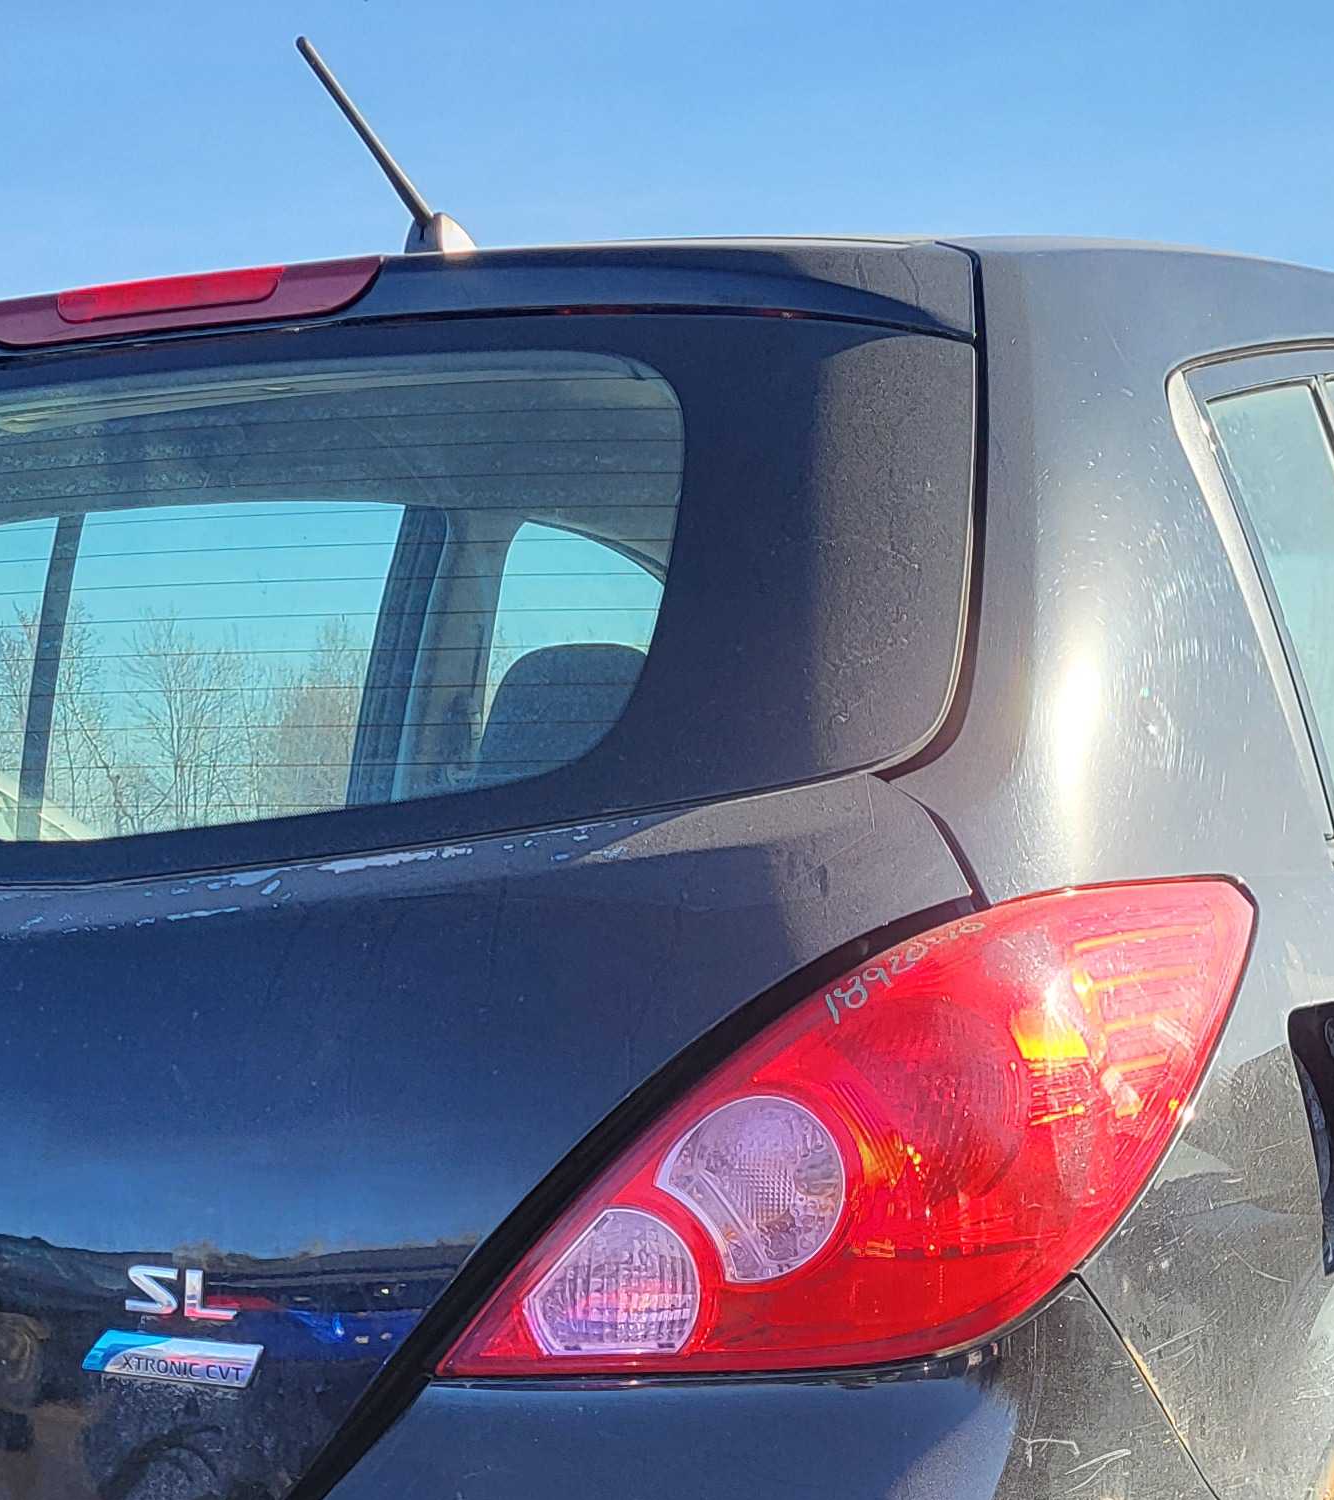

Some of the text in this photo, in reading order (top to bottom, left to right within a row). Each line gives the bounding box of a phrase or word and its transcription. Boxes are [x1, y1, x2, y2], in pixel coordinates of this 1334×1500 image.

[124, 1264, 239, 1321] SL
[122, 1355, 245, 1382] XTRONIC CVT
